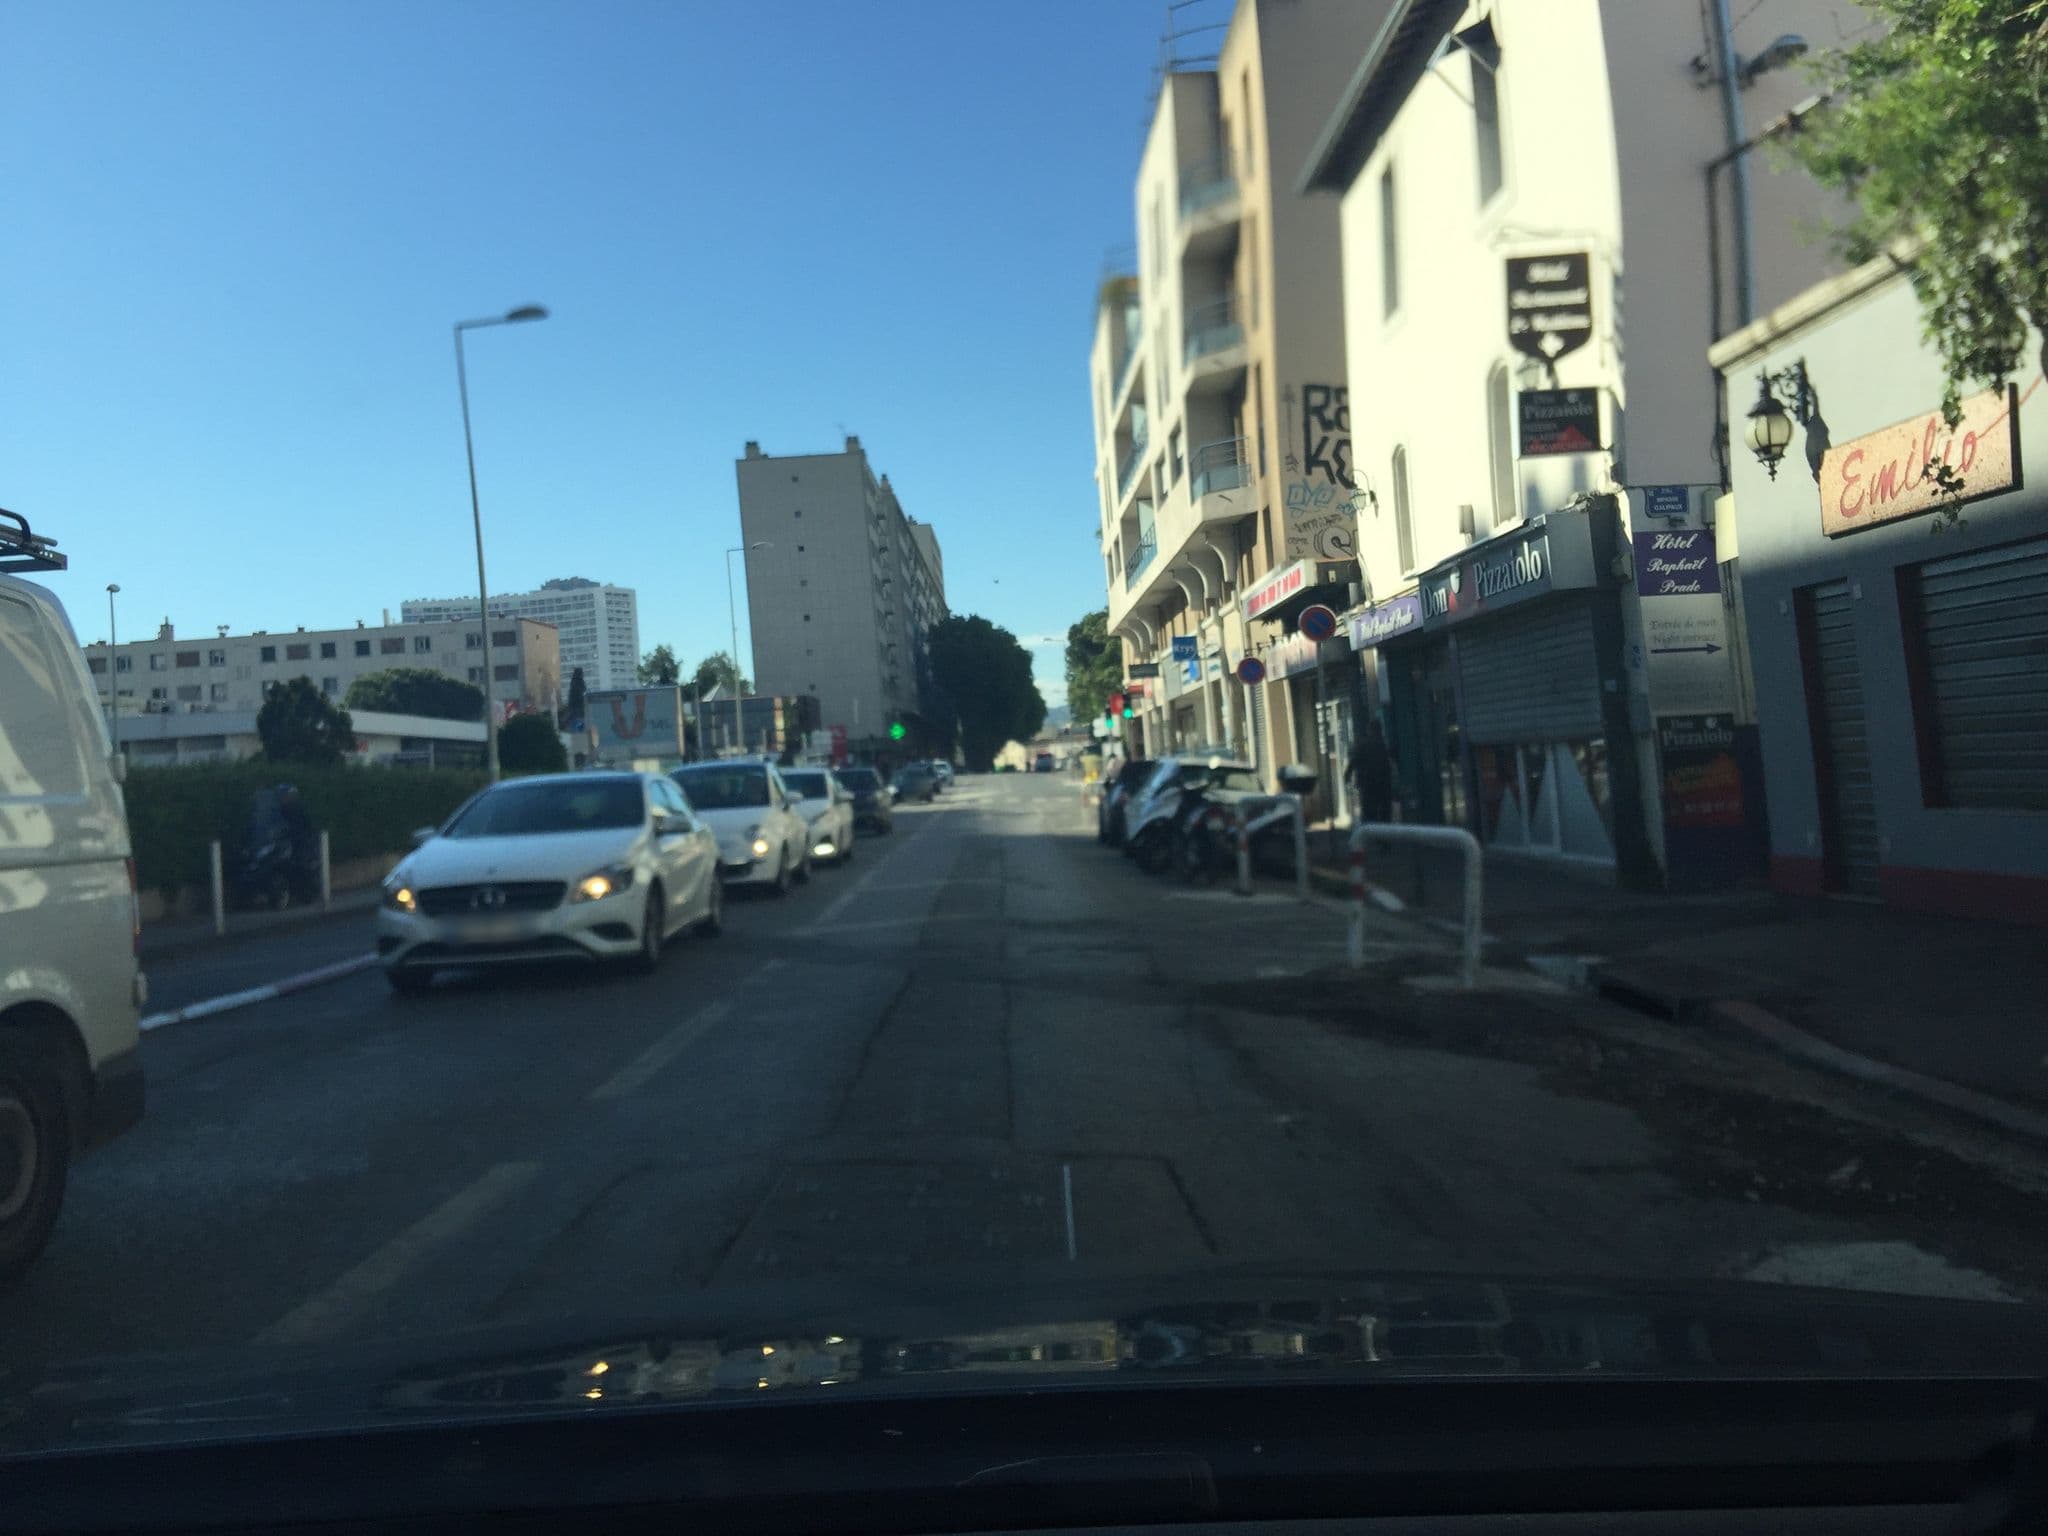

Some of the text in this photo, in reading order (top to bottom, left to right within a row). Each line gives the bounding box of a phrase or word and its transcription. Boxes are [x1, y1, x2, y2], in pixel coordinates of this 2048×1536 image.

[1839, 416, 1977, 518] Emilio
[1651, 533, 1699, 550] Hôtel
[1646, 556, 1708, 576] Raphaël
[1422, 540, 1542, 620] Don Pizzaiolo
[1659, 578, 1701, 593] Prado
